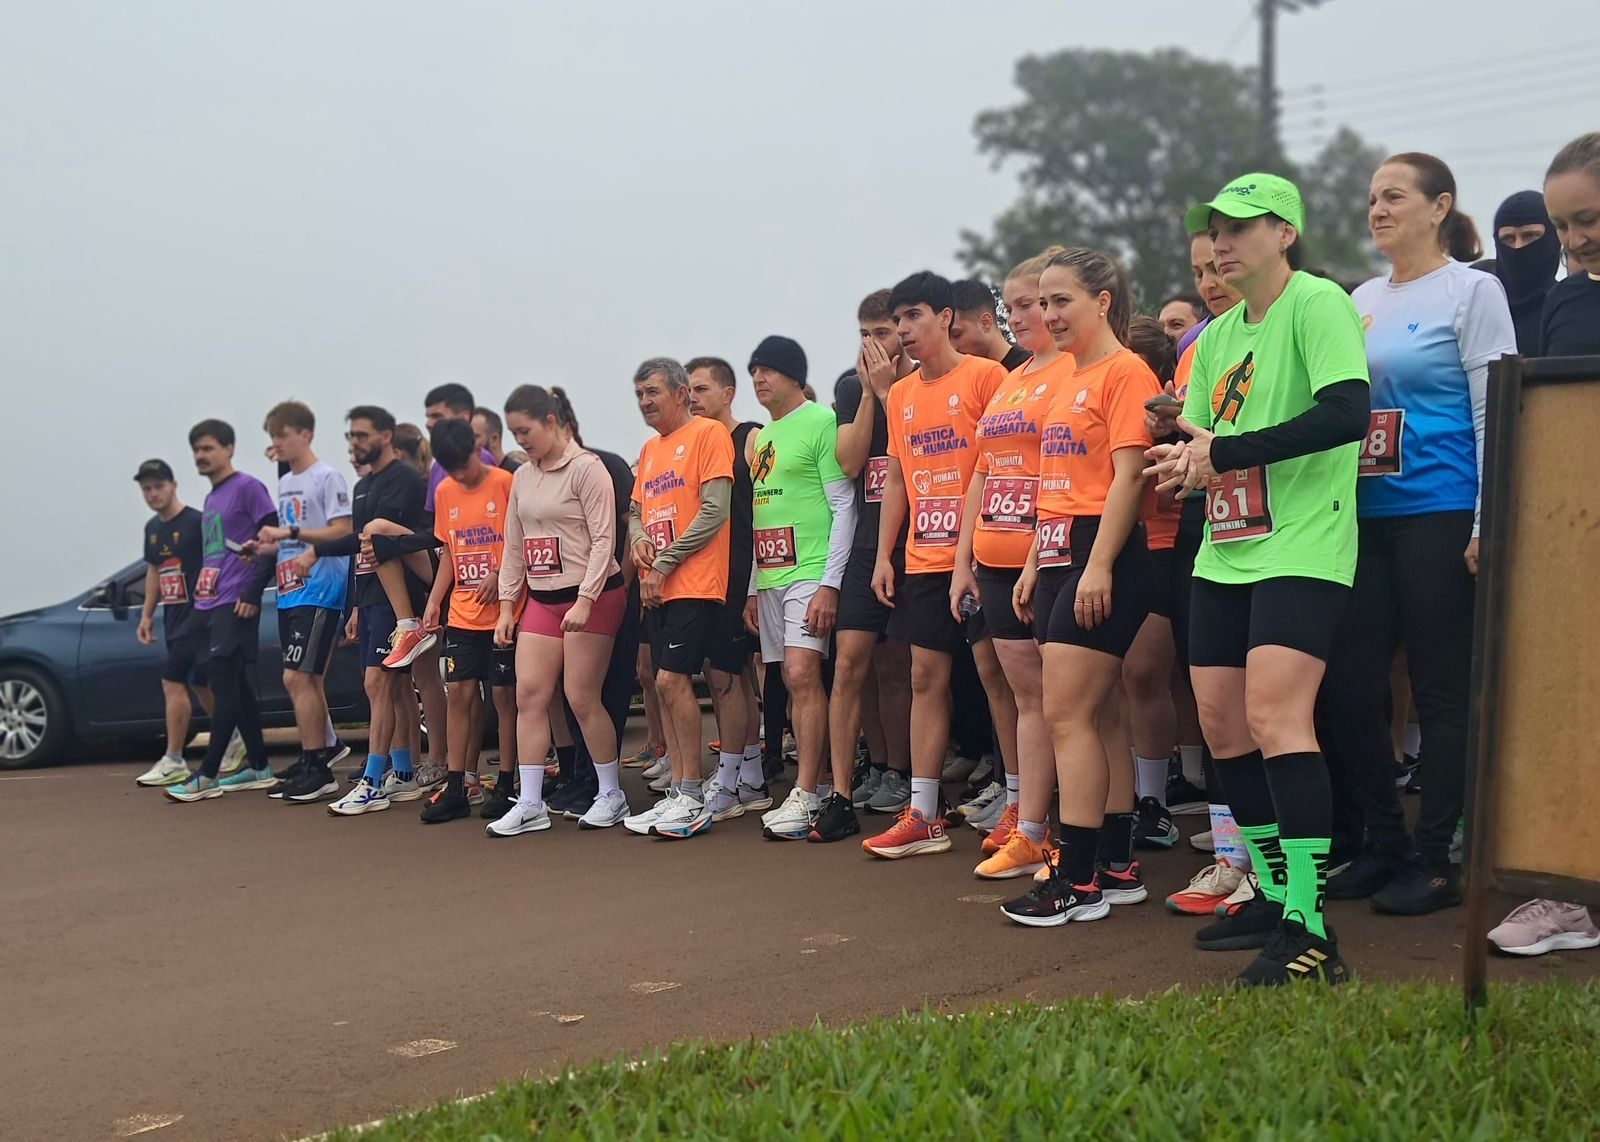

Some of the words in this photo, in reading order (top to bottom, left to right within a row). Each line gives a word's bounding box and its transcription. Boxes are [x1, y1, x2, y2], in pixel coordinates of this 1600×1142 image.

[1042, 426, 1072, 441] STICA
[913, 447, 924, 457] DE
[758, 488, 783, 497] RUNNERS
[988, 492, 1031, 515] 065
[917, 511, 957, 532] 090
[527, 548, 554, 565] 122
[758, 538, 788, 558] 093
[458, 563, 490, 580] 305
[286, 644, 303, 662] 20
[1054, 894, 1078, 911] FILA
